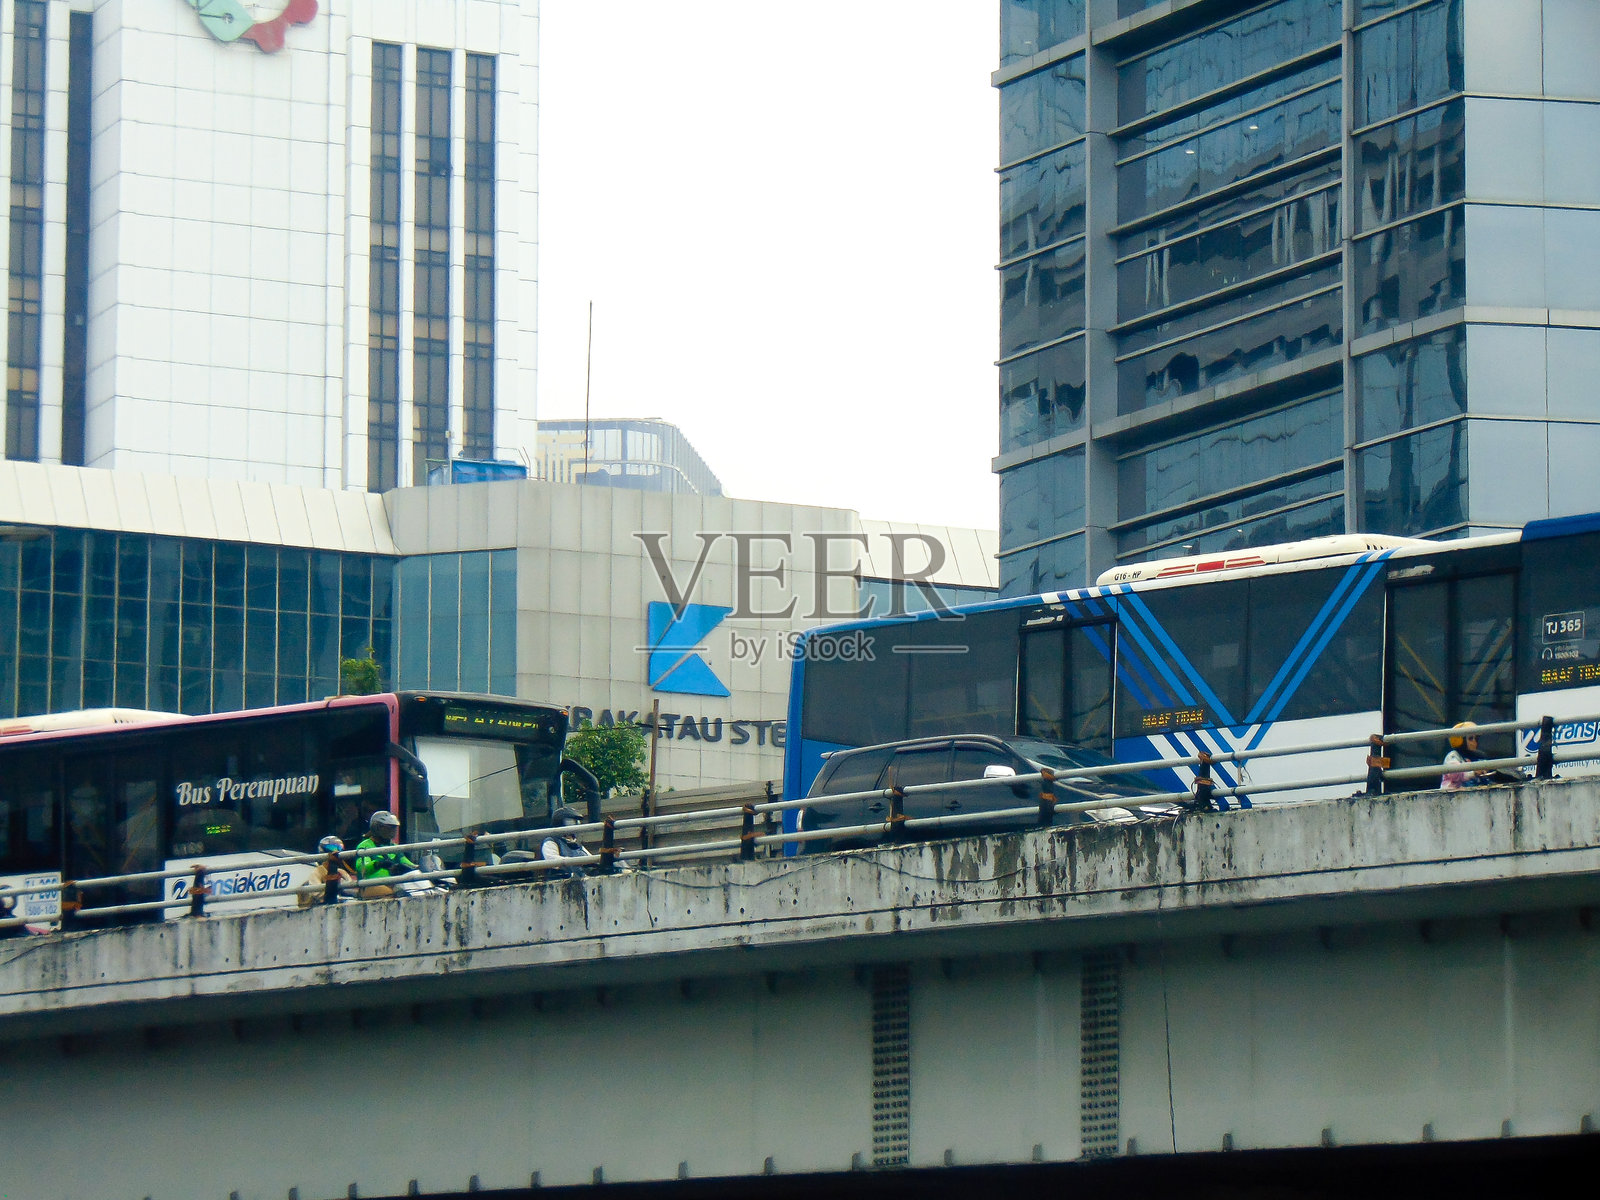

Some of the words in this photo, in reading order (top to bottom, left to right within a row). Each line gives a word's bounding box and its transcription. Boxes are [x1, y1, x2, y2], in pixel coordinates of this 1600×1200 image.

[1546, 621, 1558, 634] TJ
[1560, 618, 1581, 633] 365
[566, 705, 723, 743] RAKATAU
[176, 781, 211, 806] Bus
[216, 774, 320, 804] Perempuan
